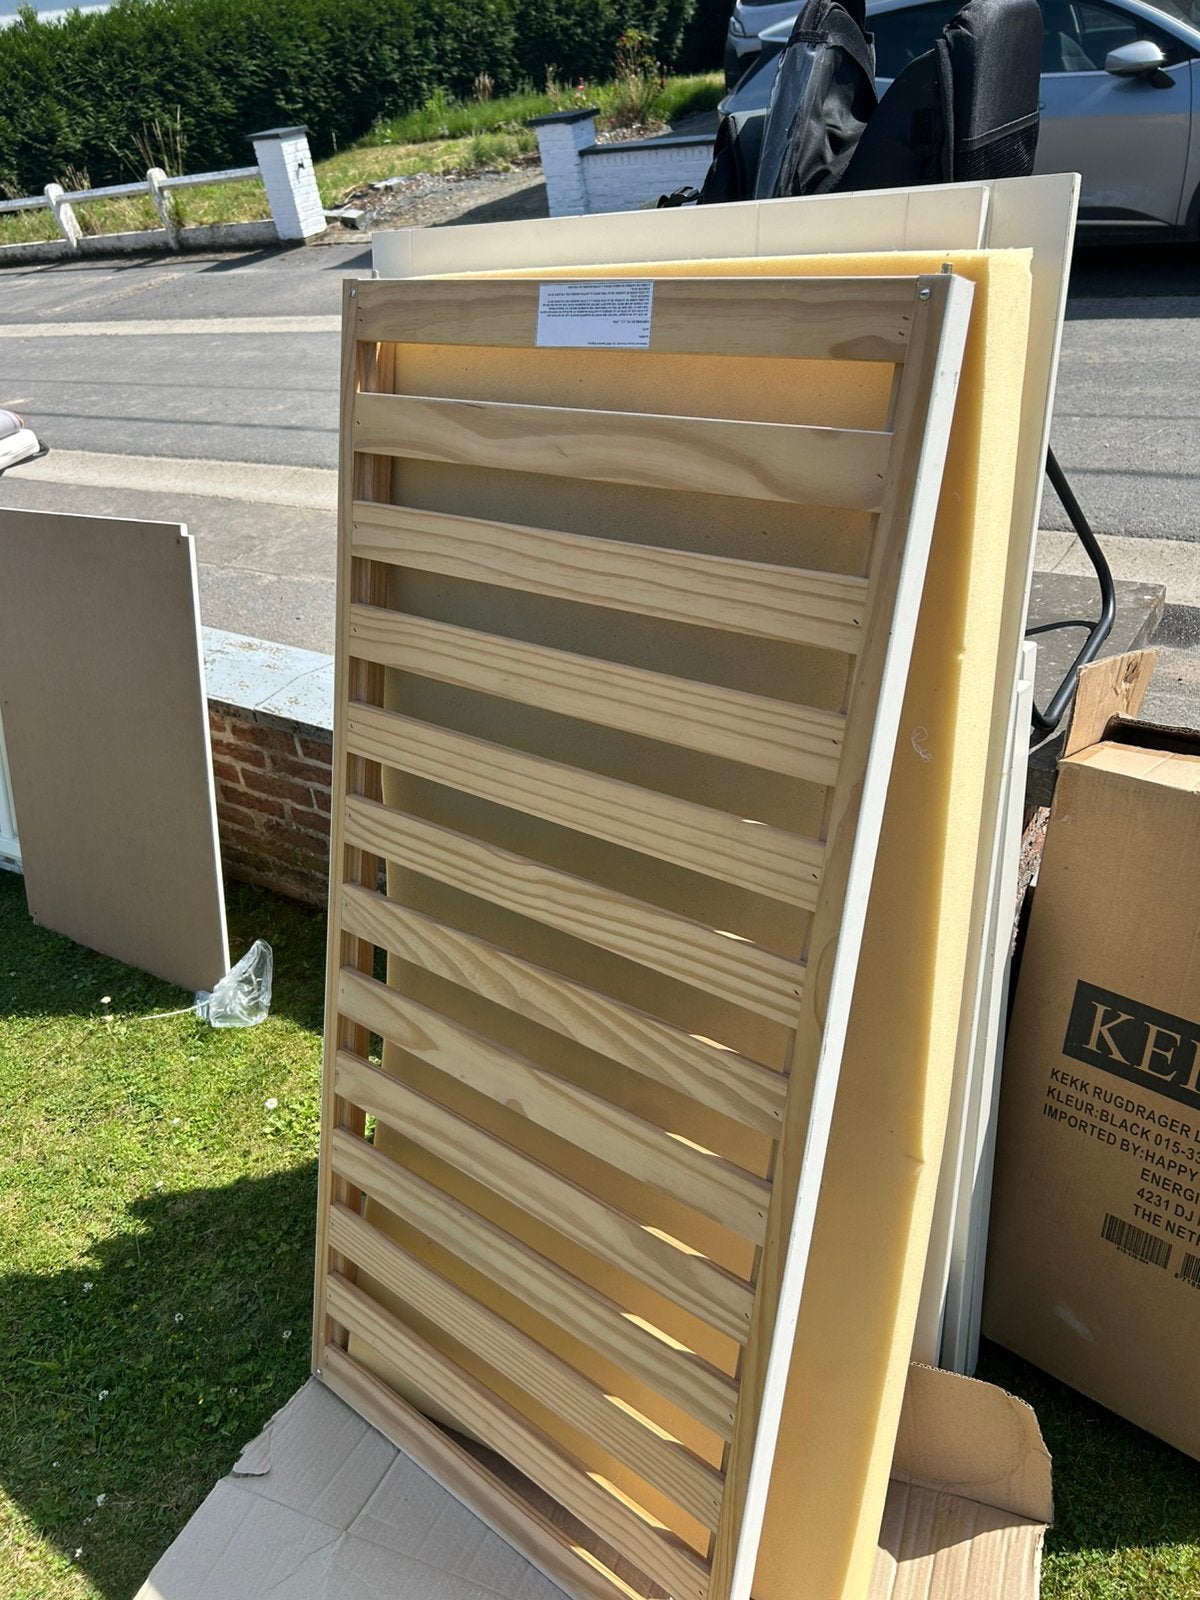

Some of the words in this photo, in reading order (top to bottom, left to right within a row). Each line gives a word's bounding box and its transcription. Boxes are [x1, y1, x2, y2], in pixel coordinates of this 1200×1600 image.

[1046, 1085, 1151, 1142] KLEUR:BLACK
[1050, 1067, 1090, 1095] KEKK
[1092, 1085, 1191, 1139] RUGDRAGER
[1042, 1103, 1117, 1146] IMPORTED
[1120, 1137, 1199, 1182] BY:HAPPY
[1136, 1187, 1170, 1211] 4231
[1174, 1203, 1194, 1222] DJ
[1140, 1167, 1200, 1205] ENERGI
[1133, 1203, 1162, 1228] THE
